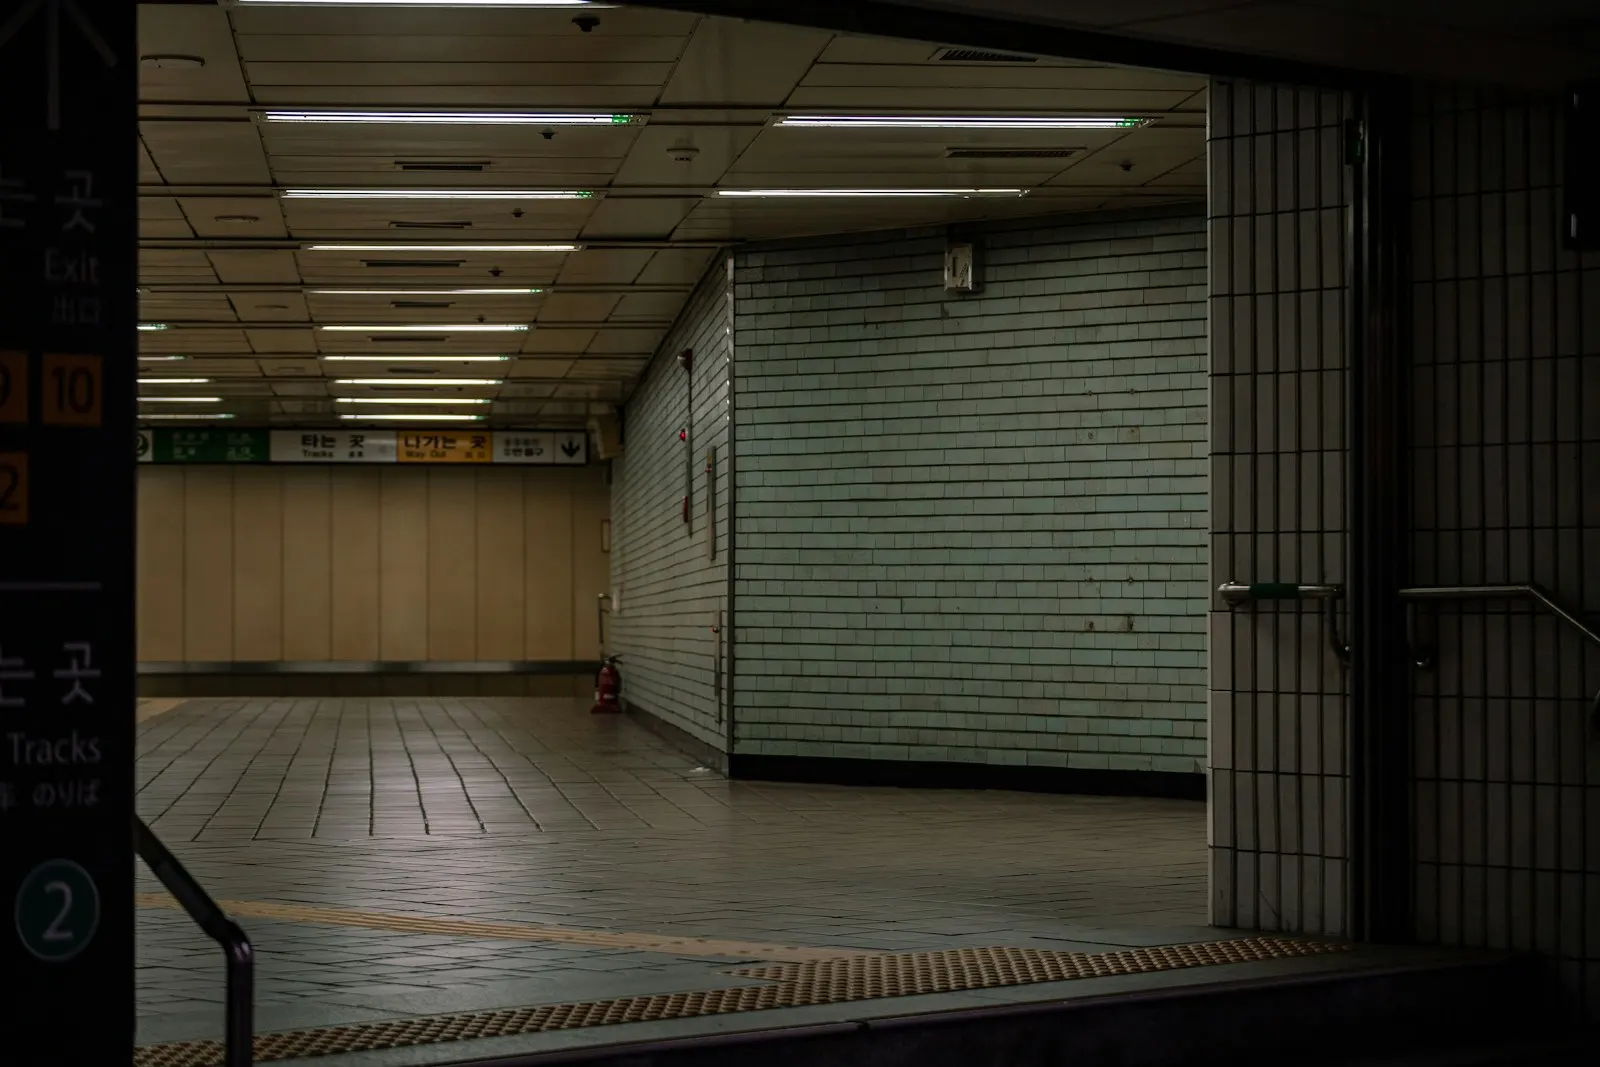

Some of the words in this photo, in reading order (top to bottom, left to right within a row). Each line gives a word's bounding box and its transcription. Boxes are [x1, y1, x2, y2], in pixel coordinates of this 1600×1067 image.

[53, 169, 103, 233] 곳
[44, 247, 100, 284] Exit
[52, 293, 100, 325] 出口
[51, 365, 95, 415] 10
[301, 434, 336, 449] 타는
[349, 434, 365, 449] 곳
[404, 435, 457, 449] 나가는
[52, 640, 102, 706] 곳
[6, 728, 102, 767] Tracks
[31, 777, 103, 809] のりば
[41, 879, 75, 941] 2
